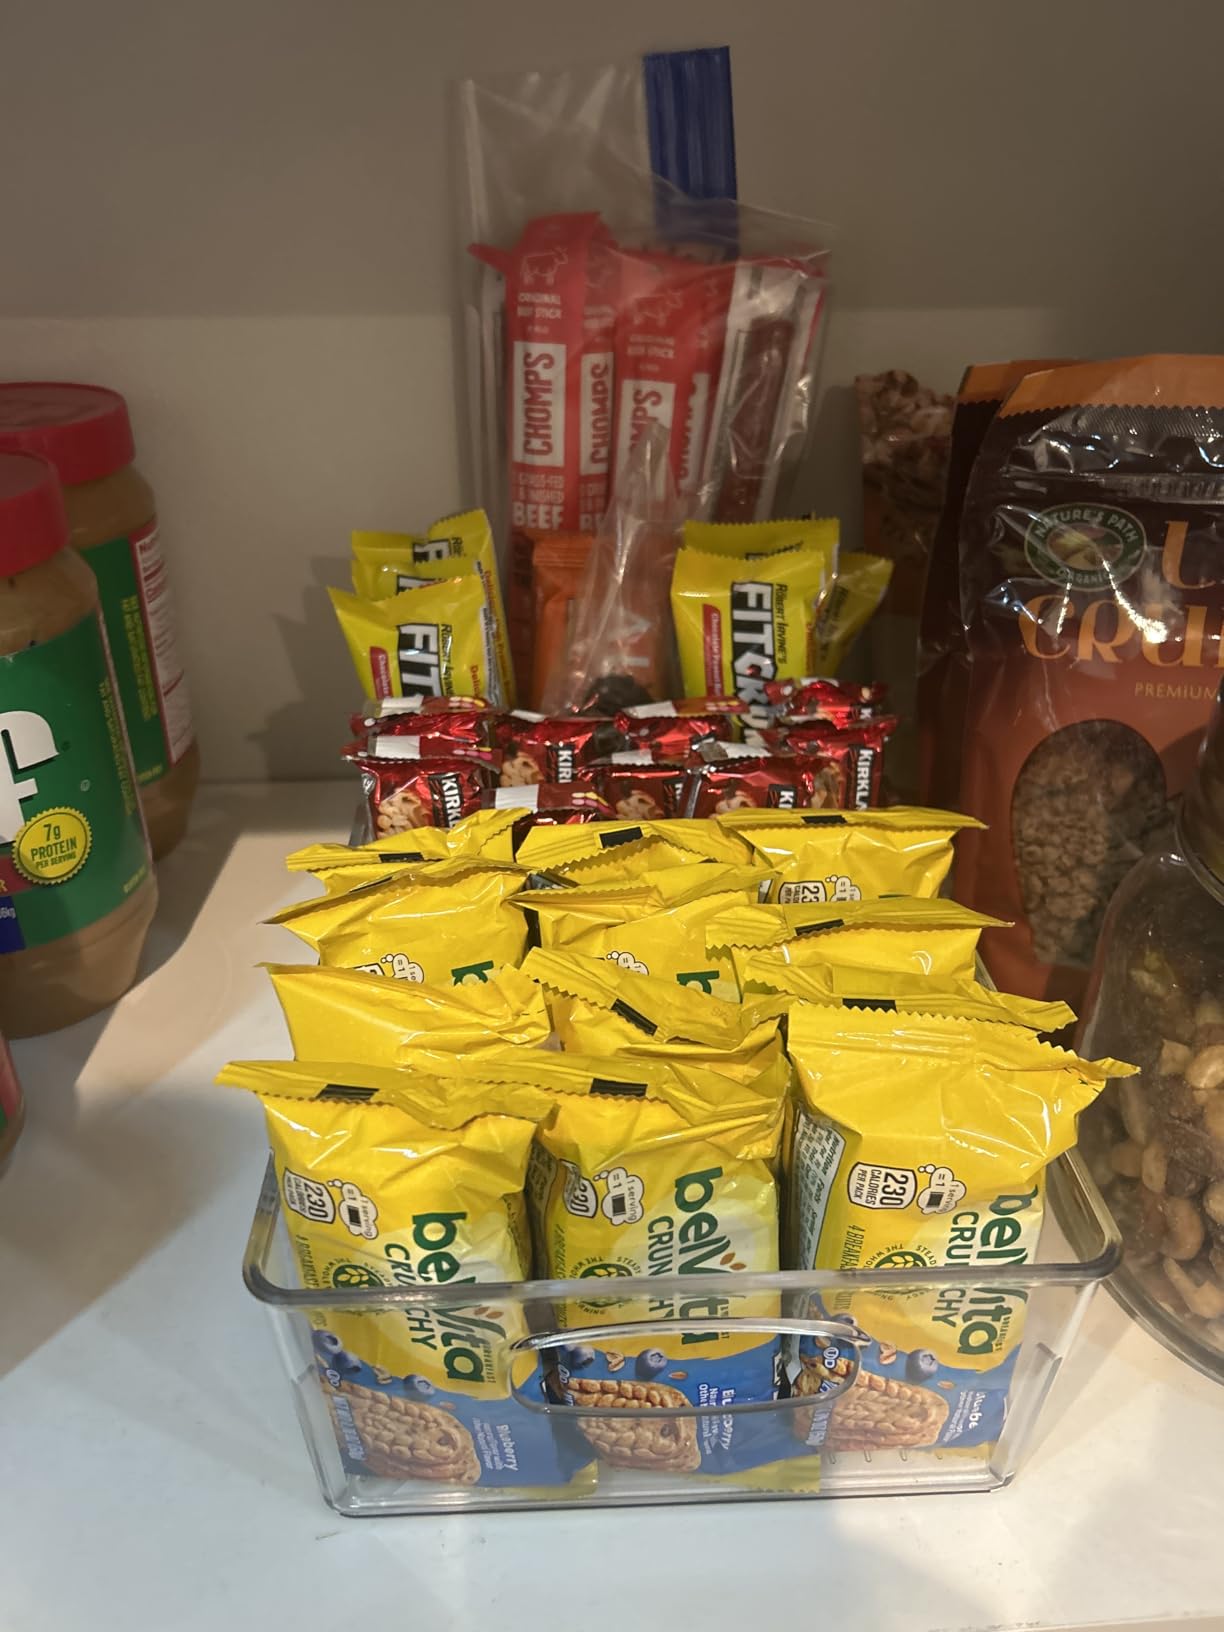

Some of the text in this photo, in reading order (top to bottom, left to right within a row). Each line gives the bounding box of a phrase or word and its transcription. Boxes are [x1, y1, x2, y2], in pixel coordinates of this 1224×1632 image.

[523, 351, 555, 457] CHOMPS
[512, 502, 564, 530] BEEF
[1106, 514, 1139, 543] PATH
[855, 749, 874, 811] KIRKLA
[440, 774, 463, 828] KIRKL
[30, 836, 78, 861] PROTEIN
[43, 823, 62, 842] 7g
[801, 885, 820, 903] 23
[814, 1135, 840, 1205] Nutrition Facts
[853, 1168, 868, 1200] PER PACK
[865, 1168, 882, 1206] CALORIES
[303, 1182, 329, 1219] 230
[627, 1185, 638, 1221] serving
[879, 1171, 909, 1206] 230
[361, 1204, 374, 1238] serving
[616, 1256, 643, 1275] STEADY
[840, 1232, 865, 1271] BREAKFAS
[916, 1244, 938, 1266] STEAD
